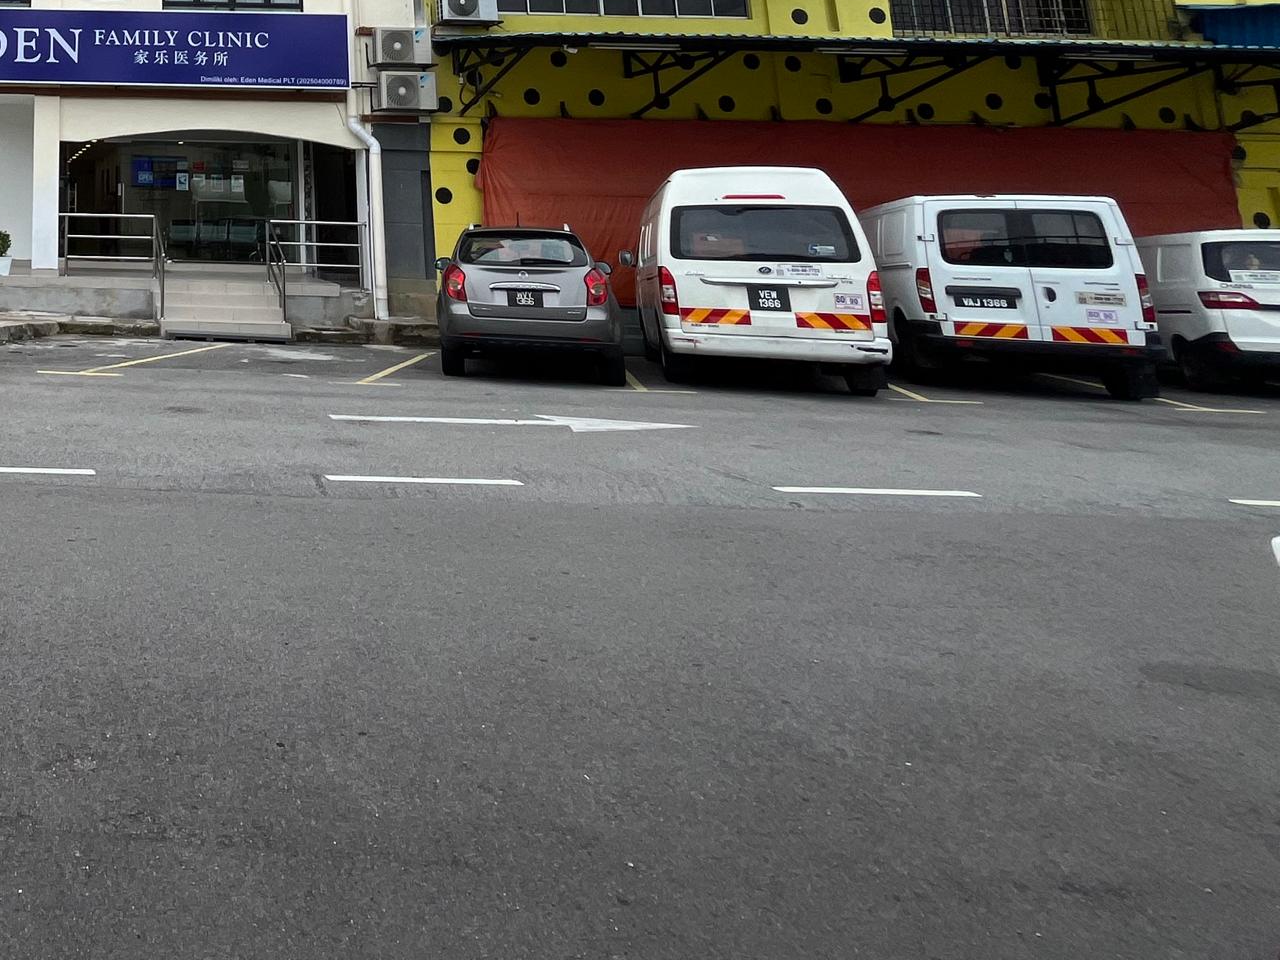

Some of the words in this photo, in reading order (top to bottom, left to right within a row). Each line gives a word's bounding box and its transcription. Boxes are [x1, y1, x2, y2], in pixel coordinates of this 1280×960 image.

[94, 29, 179, 47] FAMILY
[187, 31, 269, 49] CLINIC
[133, 49, 229, 67] 家乐医务所
[240, 76, 257, 84] Eden
[758, 290, 777, 299] VEW
[758, 298, 781, 308] 1366
[962, 297, 980, 307] VAJ
[982, 298, 1007, 308] 1366
